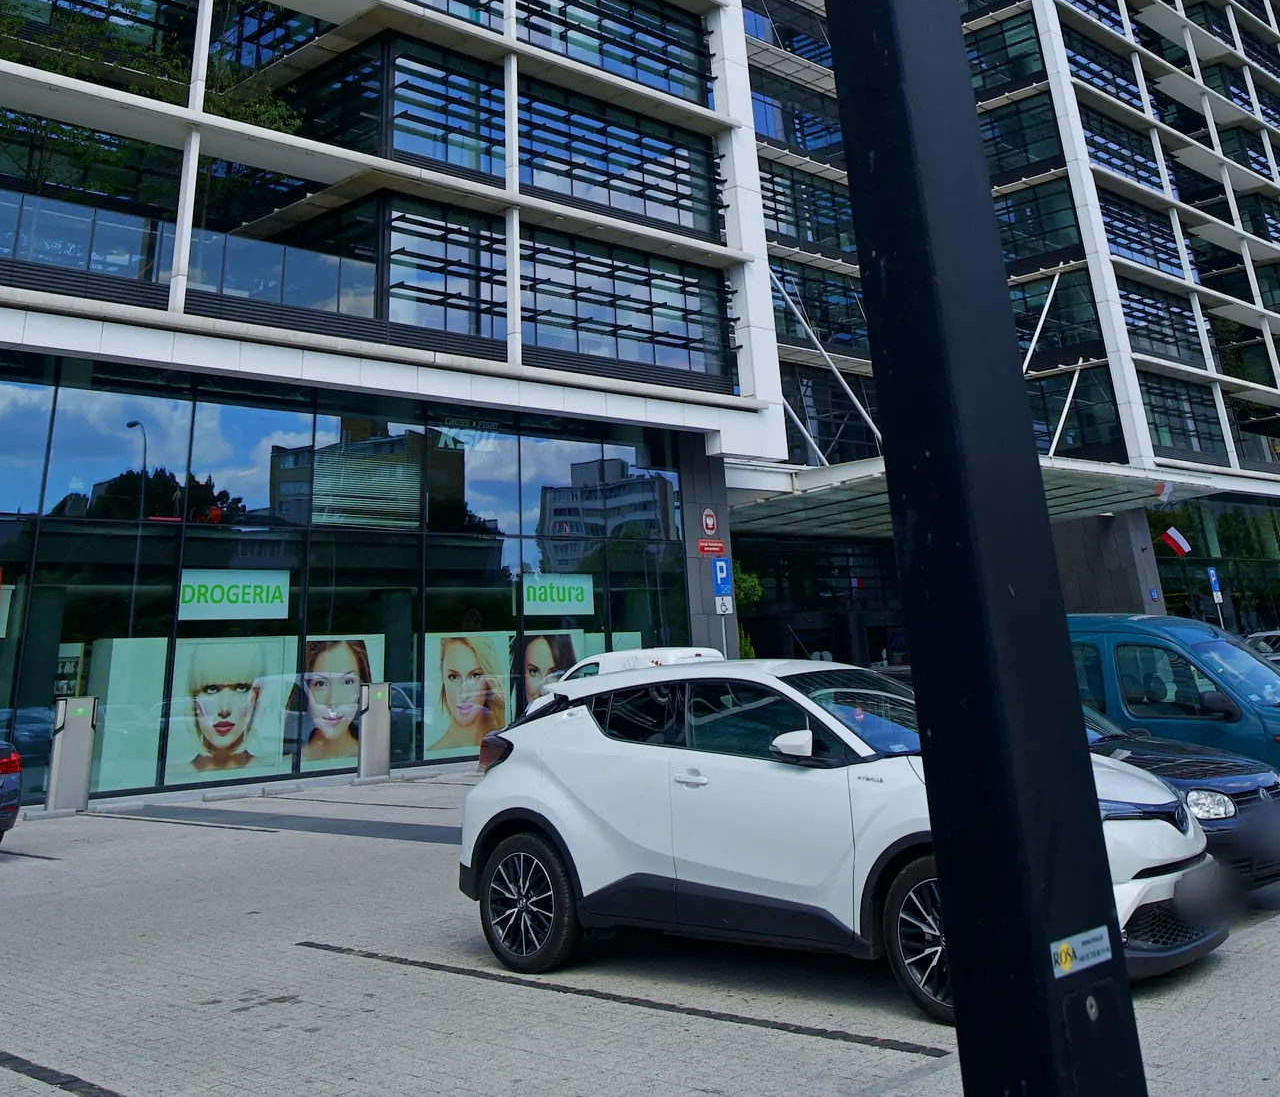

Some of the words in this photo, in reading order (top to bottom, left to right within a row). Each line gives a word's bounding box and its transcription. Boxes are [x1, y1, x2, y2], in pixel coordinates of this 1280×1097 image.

[716, 561, 727, 584] P
[180, 582, 285, 606] DROGERIA
[525, 580, 585, 604] natura
